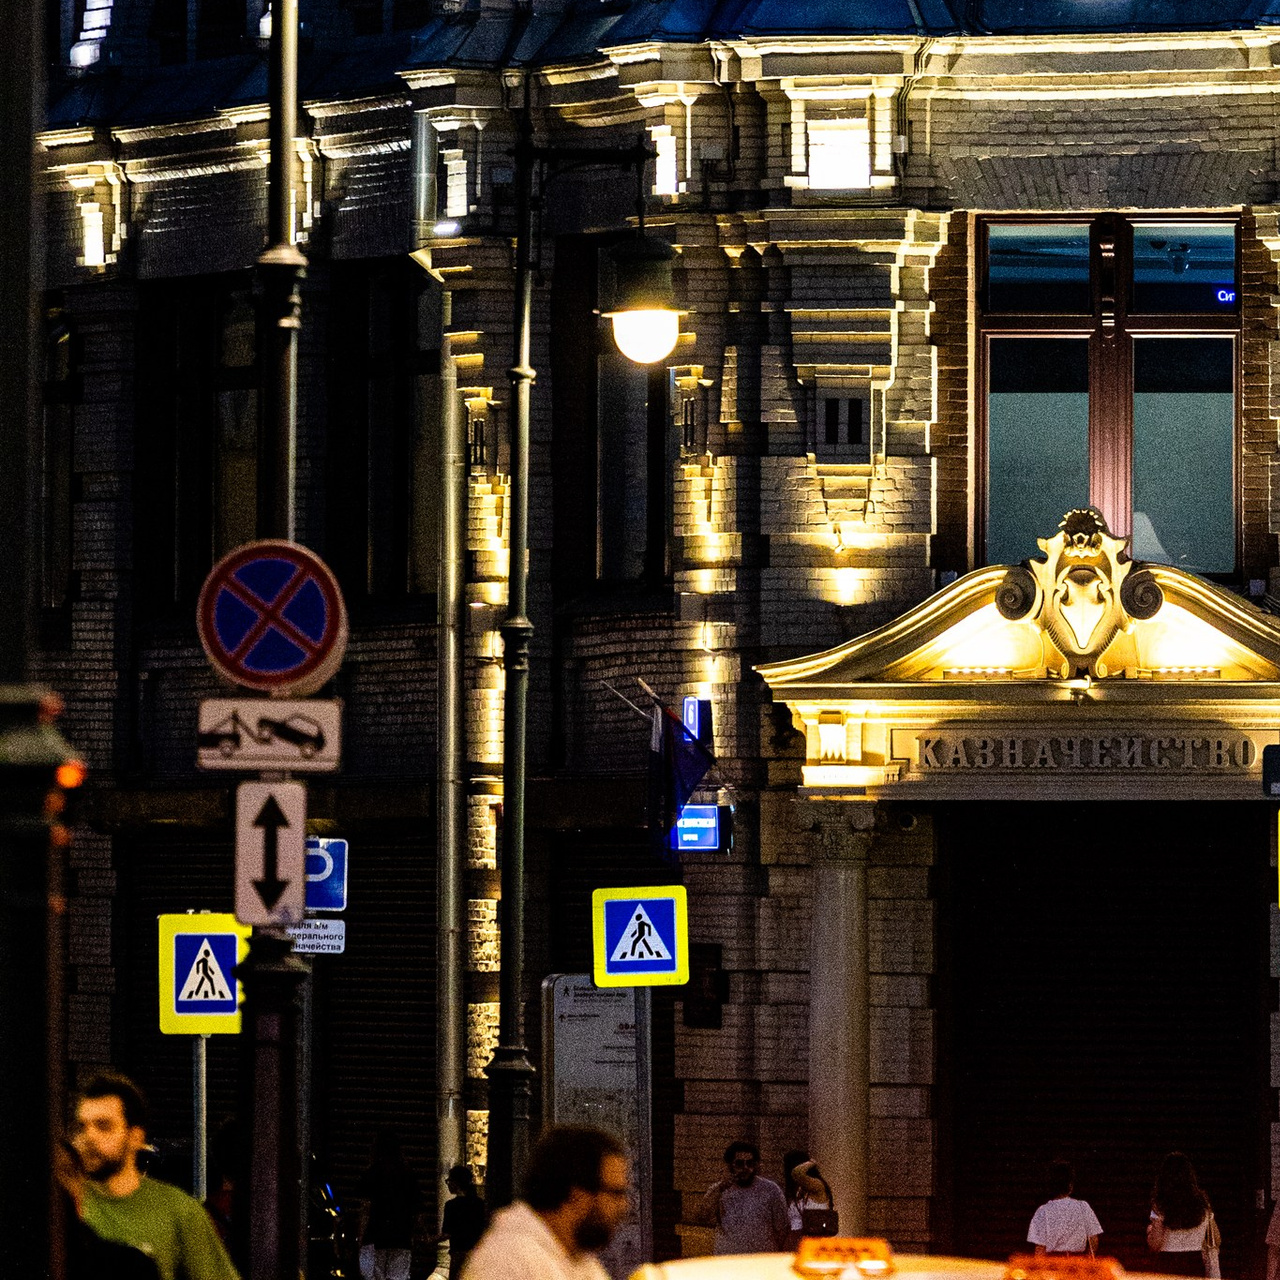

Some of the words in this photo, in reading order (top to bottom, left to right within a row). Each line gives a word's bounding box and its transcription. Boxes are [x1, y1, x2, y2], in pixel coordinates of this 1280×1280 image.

[918, 734, 1257, 768] КАЗНАЧЕЙСТВО
[286, 933, 344, 941] едерального
[292, 942, 341, 951] начейства
